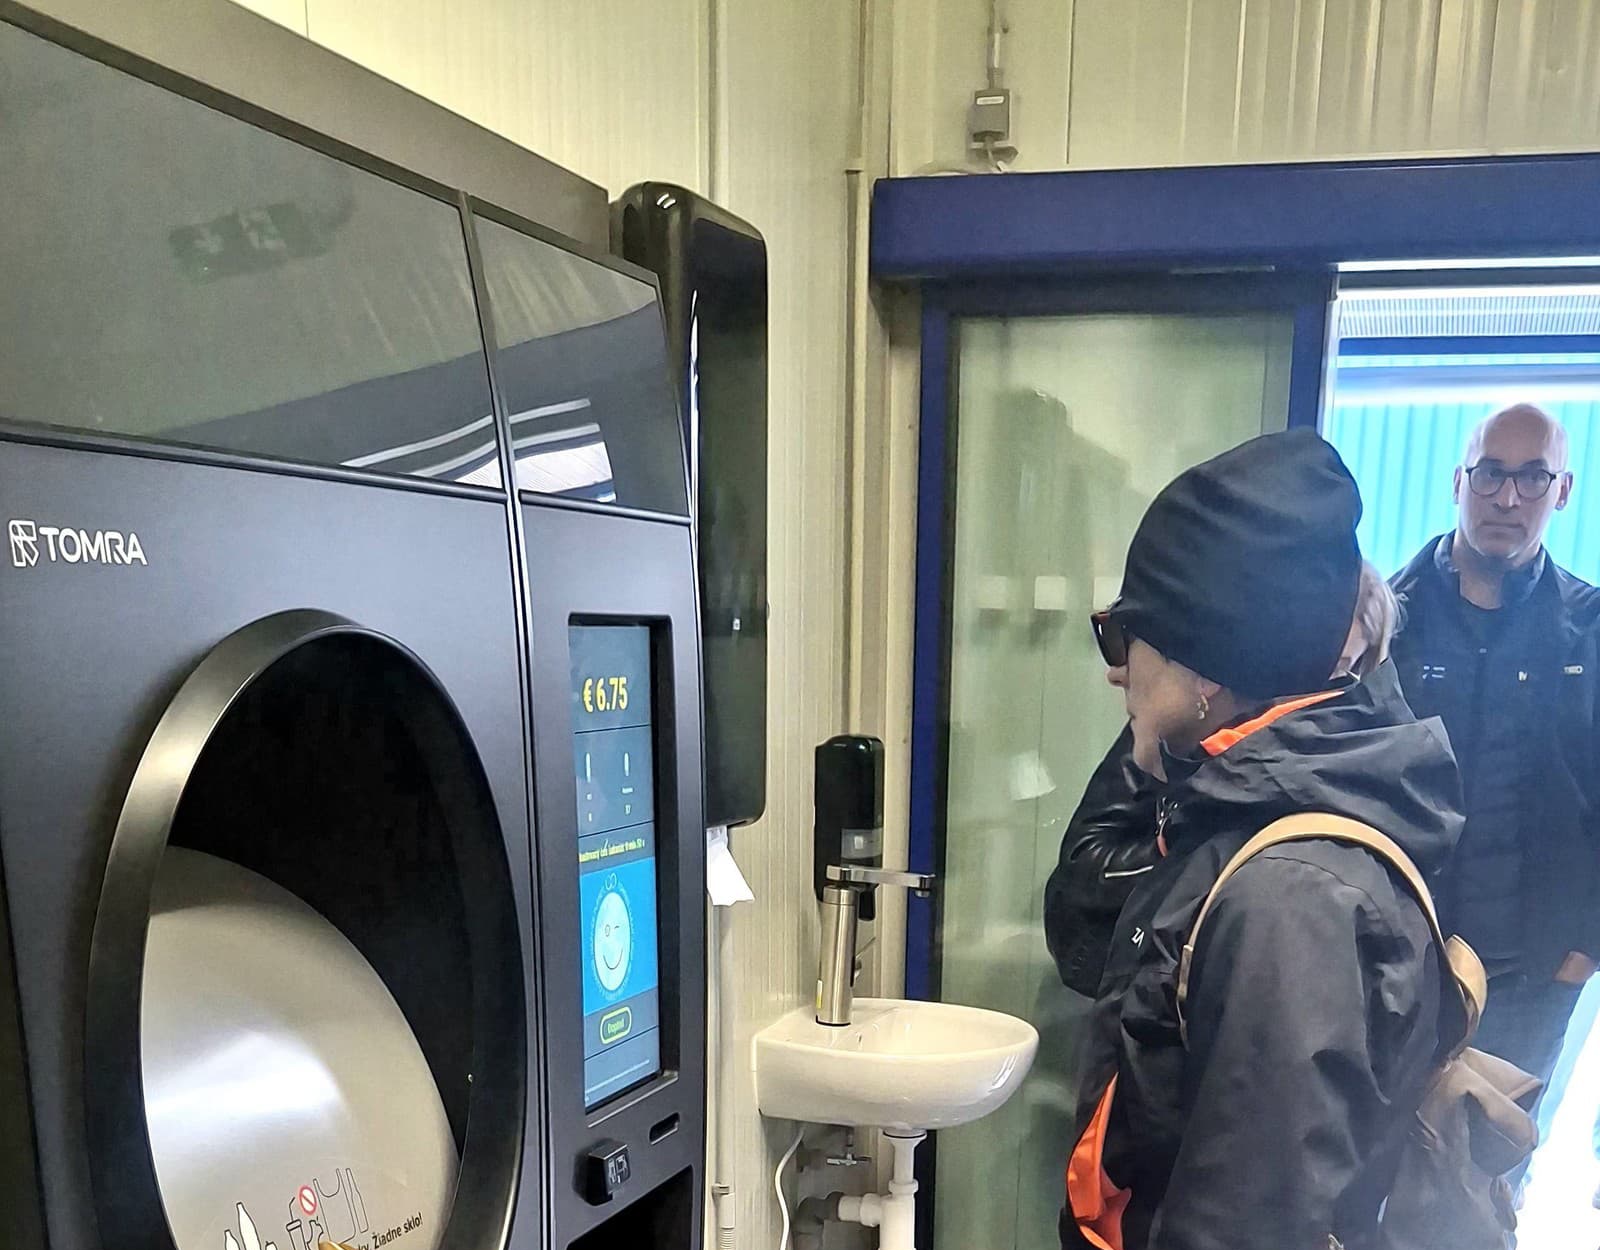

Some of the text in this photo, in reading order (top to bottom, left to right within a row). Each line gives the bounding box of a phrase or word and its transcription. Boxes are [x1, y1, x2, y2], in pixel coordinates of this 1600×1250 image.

[38, 526, 149, 566] TOMRA
[583, 677, 628, 713] € 6.75
[372, 1231, 402, 1250] Žiadne
[403, 1211, 423, 1234] sklo!
